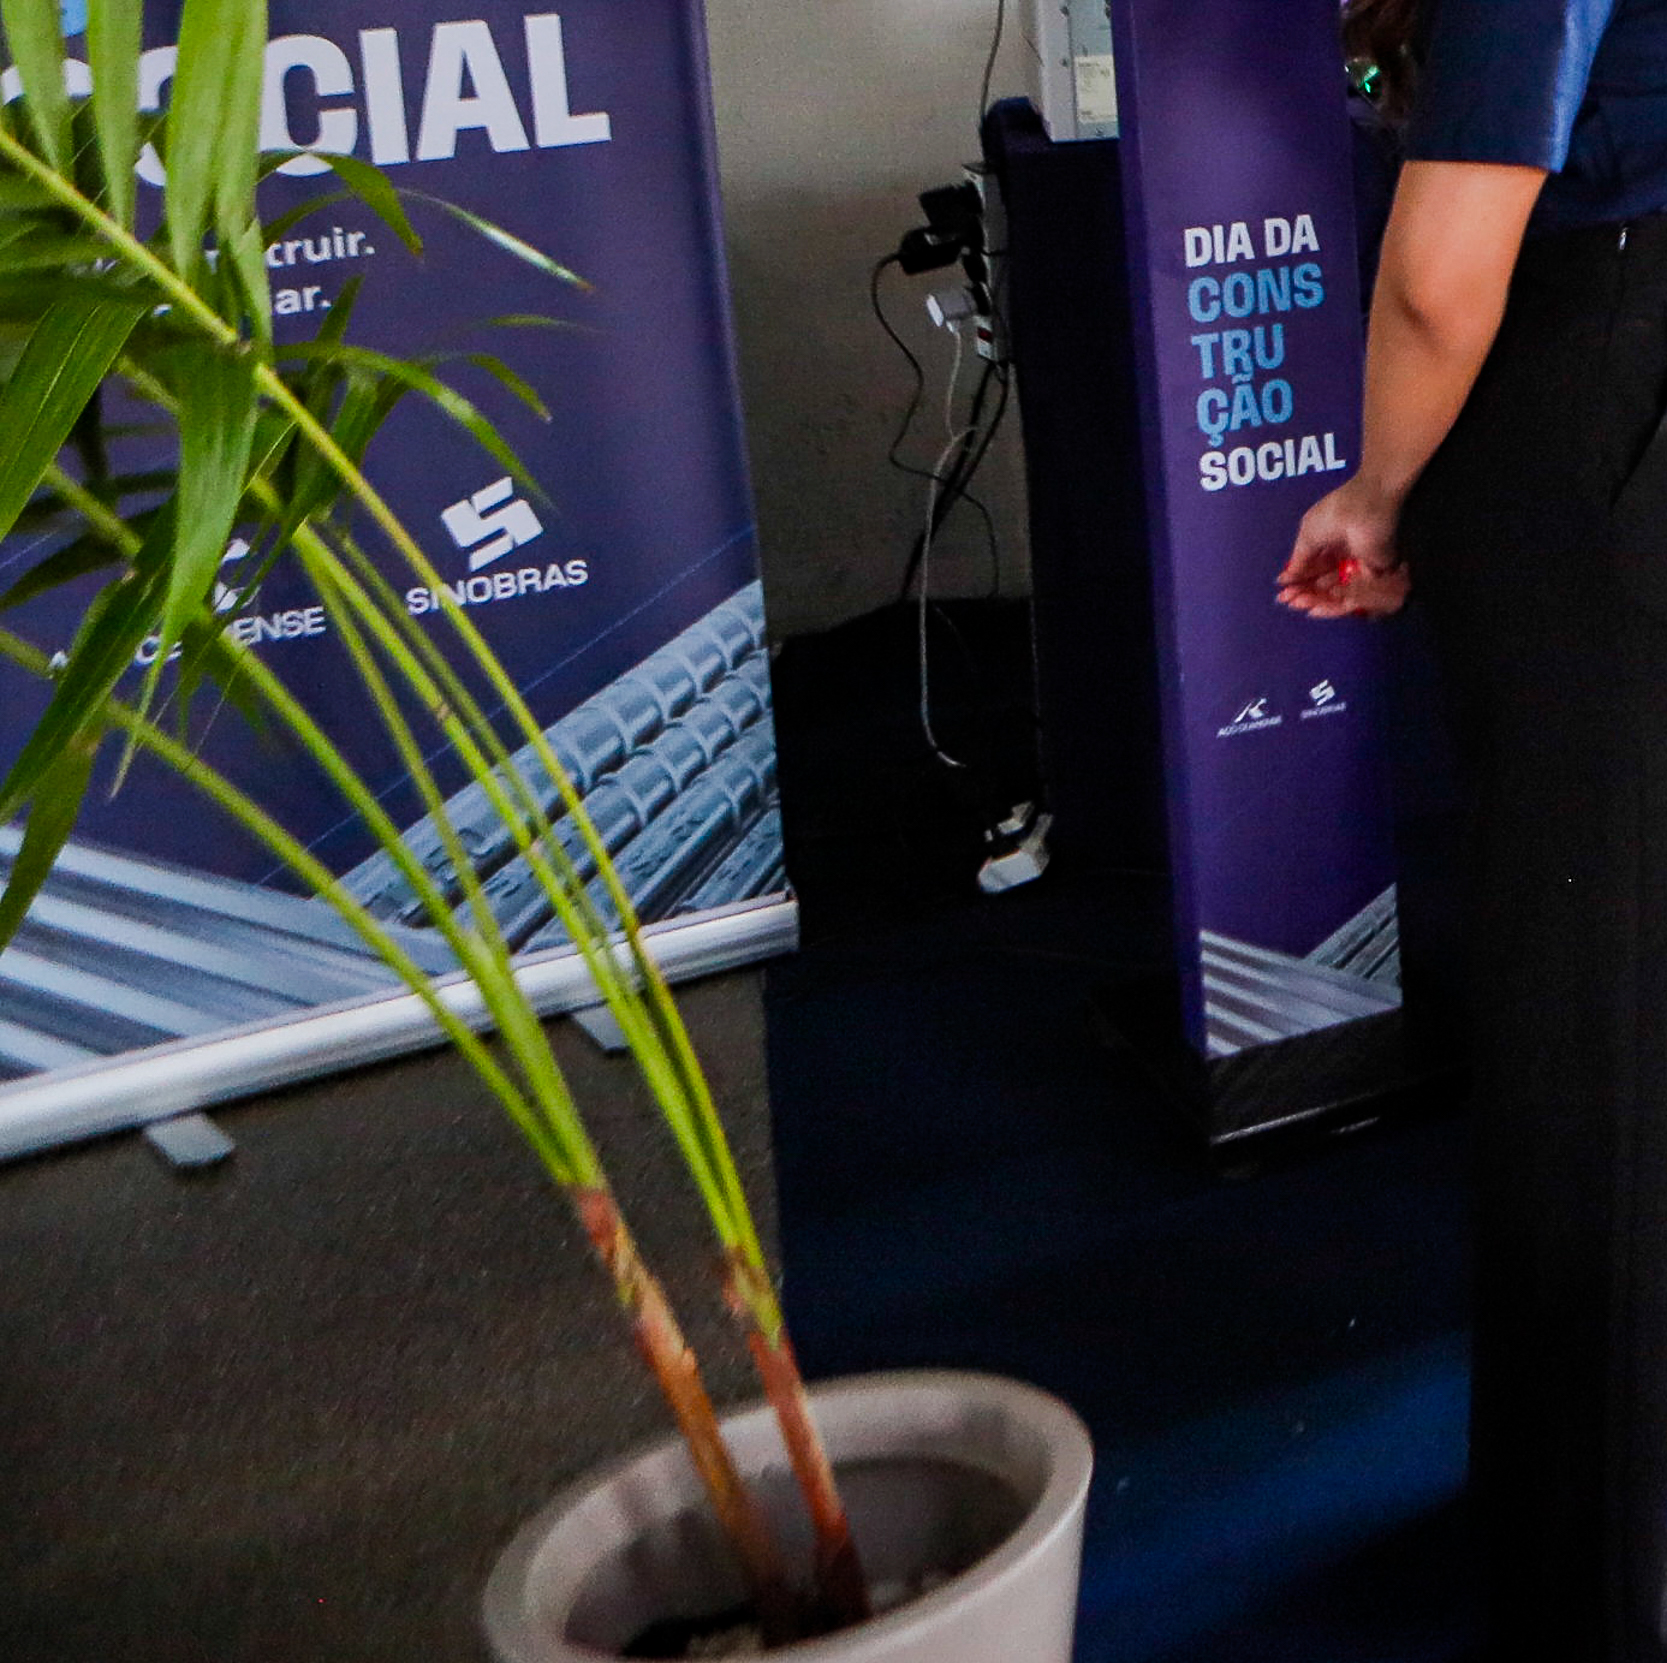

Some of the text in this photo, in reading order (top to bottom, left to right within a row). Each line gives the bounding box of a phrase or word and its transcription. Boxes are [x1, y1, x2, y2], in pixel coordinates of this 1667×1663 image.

[1184, 214, 1320, 268] DIA DA
[1187, 262, 1325, 325] CONS
[1191, 323, 1285, 380] TRU
[1196, 370, 1295, 447] ÇÃO
[1200, 433, 1347, 492] SOCIAL
